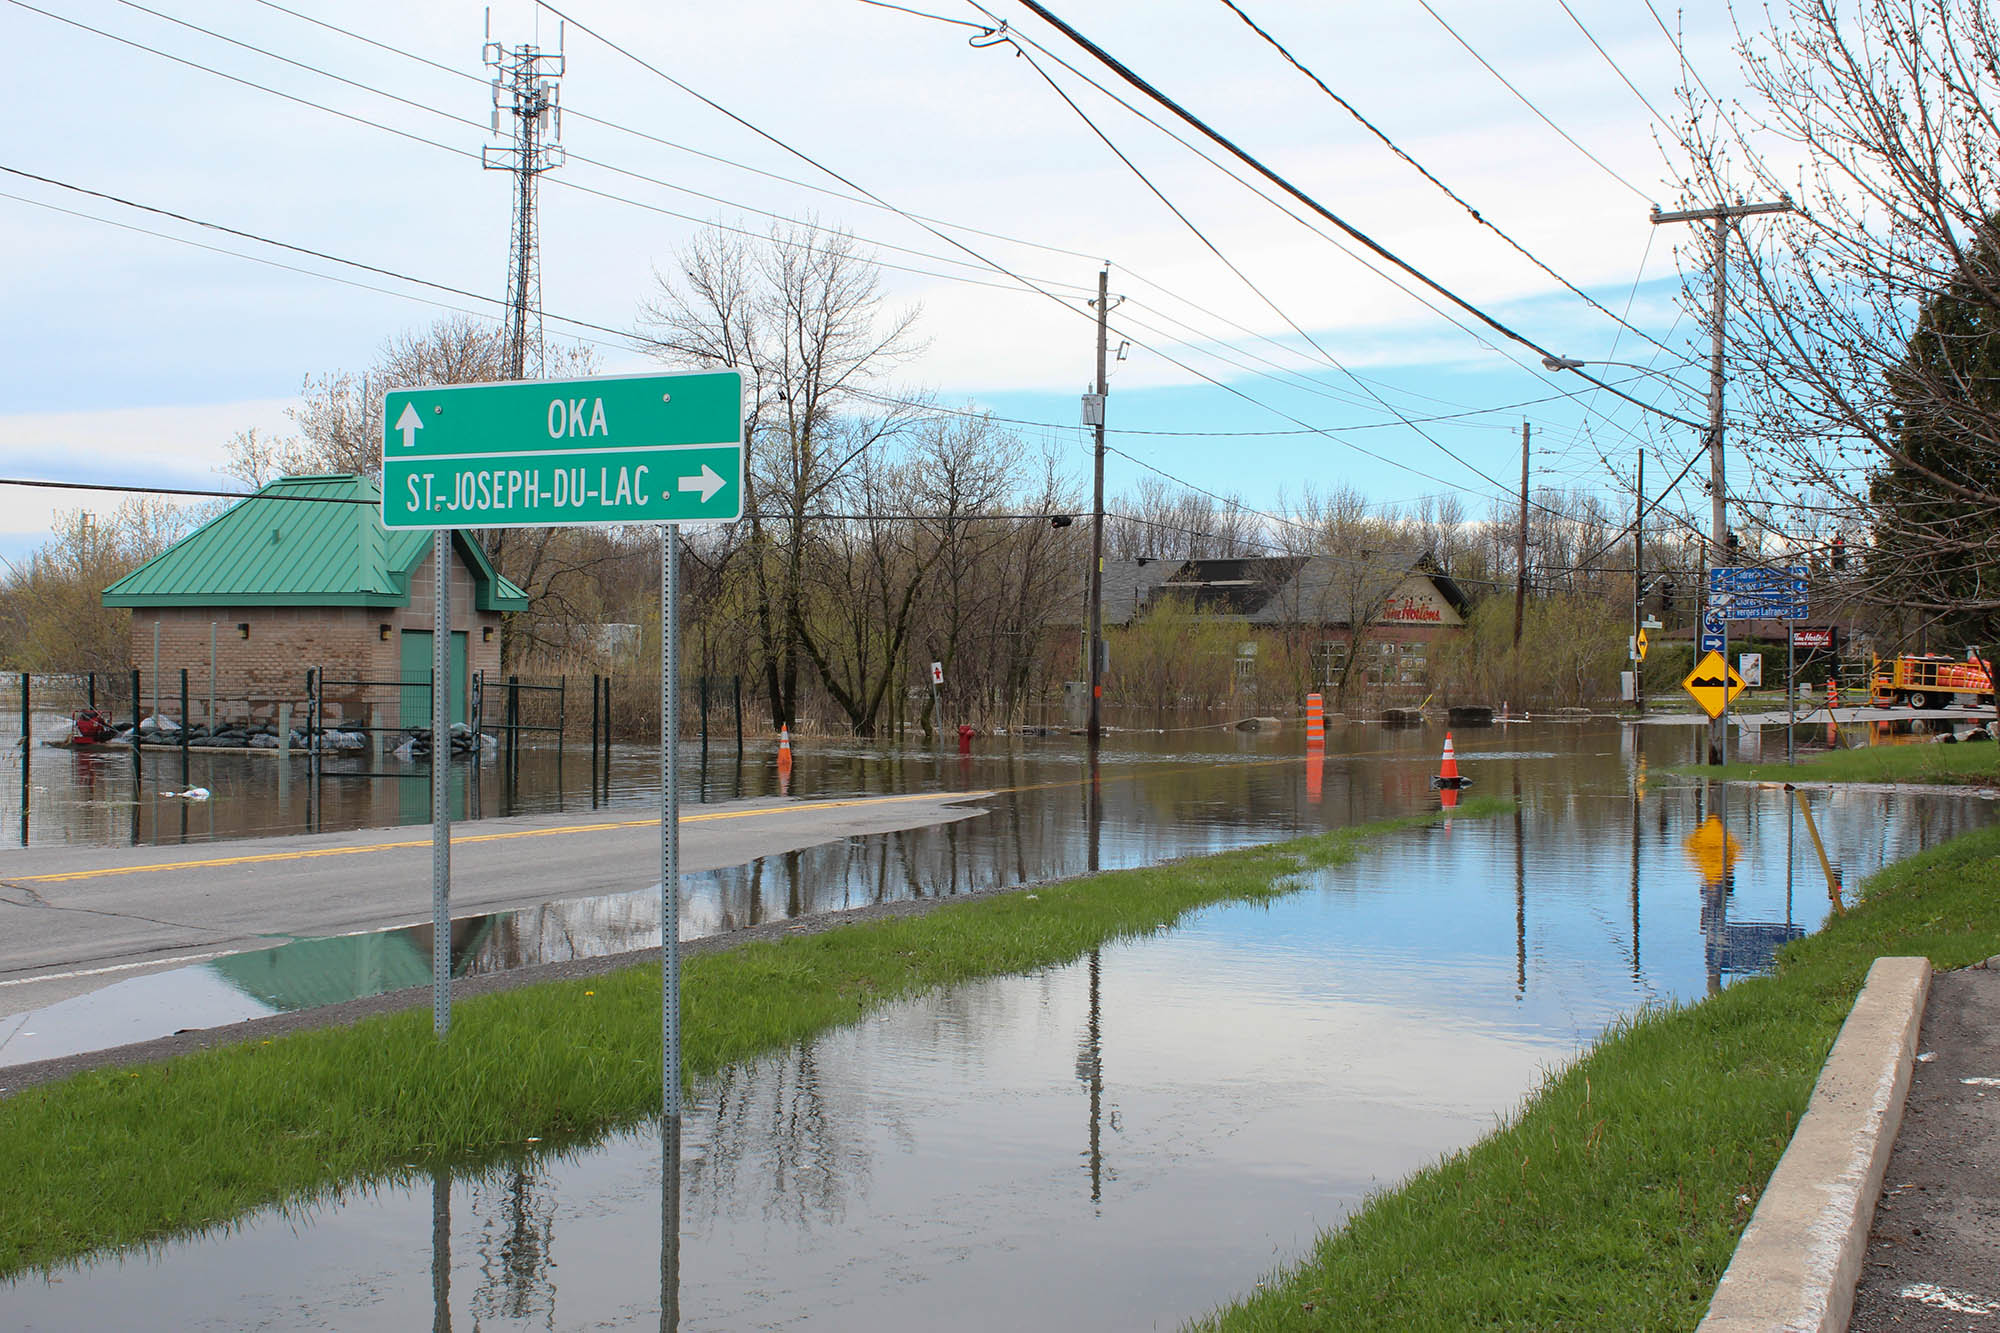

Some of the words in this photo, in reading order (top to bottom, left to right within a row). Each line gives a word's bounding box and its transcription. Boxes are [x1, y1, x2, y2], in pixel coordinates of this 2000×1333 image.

[547, 398, 609, 439] OKA
[406, 465, 649, 512] ST-JOSEPH-DU-LAC
[1402, 599, 1441, 621] Hortons
